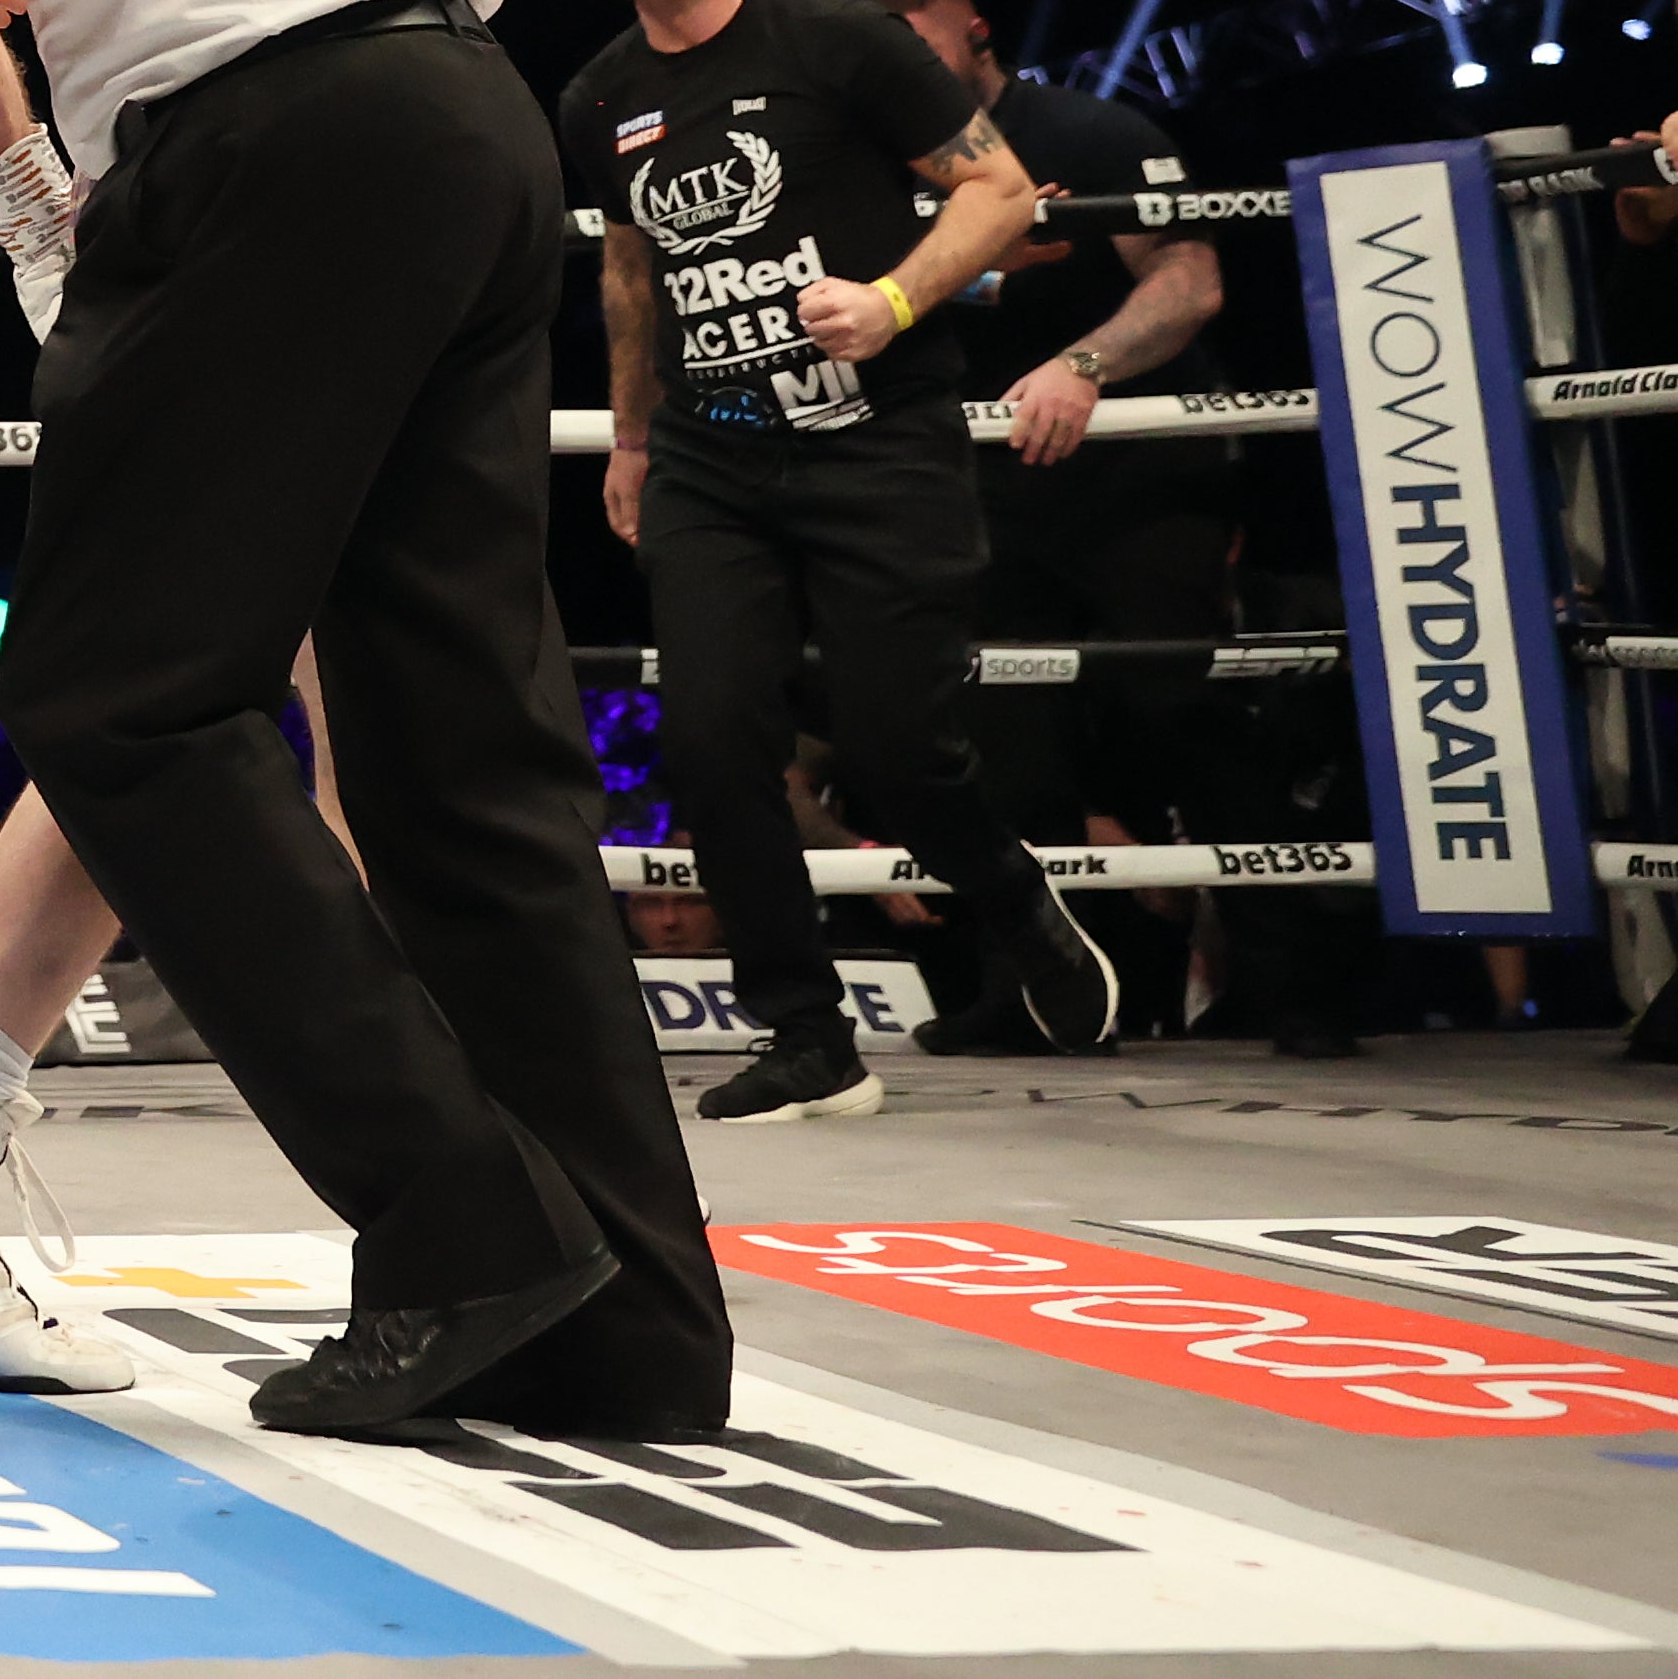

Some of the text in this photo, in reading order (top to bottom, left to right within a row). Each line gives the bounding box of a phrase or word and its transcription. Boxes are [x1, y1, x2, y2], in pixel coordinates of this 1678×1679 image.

[649, 158, 750, 219] MTK
[1178, 189, 1293, 220] BOXXE
[673, 201, 735, 230] GLOBAL
[683, 305, 796, 361] ACER
[1553, 372, 1639, 401] Arnold
[1357, 214, 1513, 862] WOWHYDRATE
[985, 655, 1075, 679] sports
[1213, 842, 1352, 875] bet365
